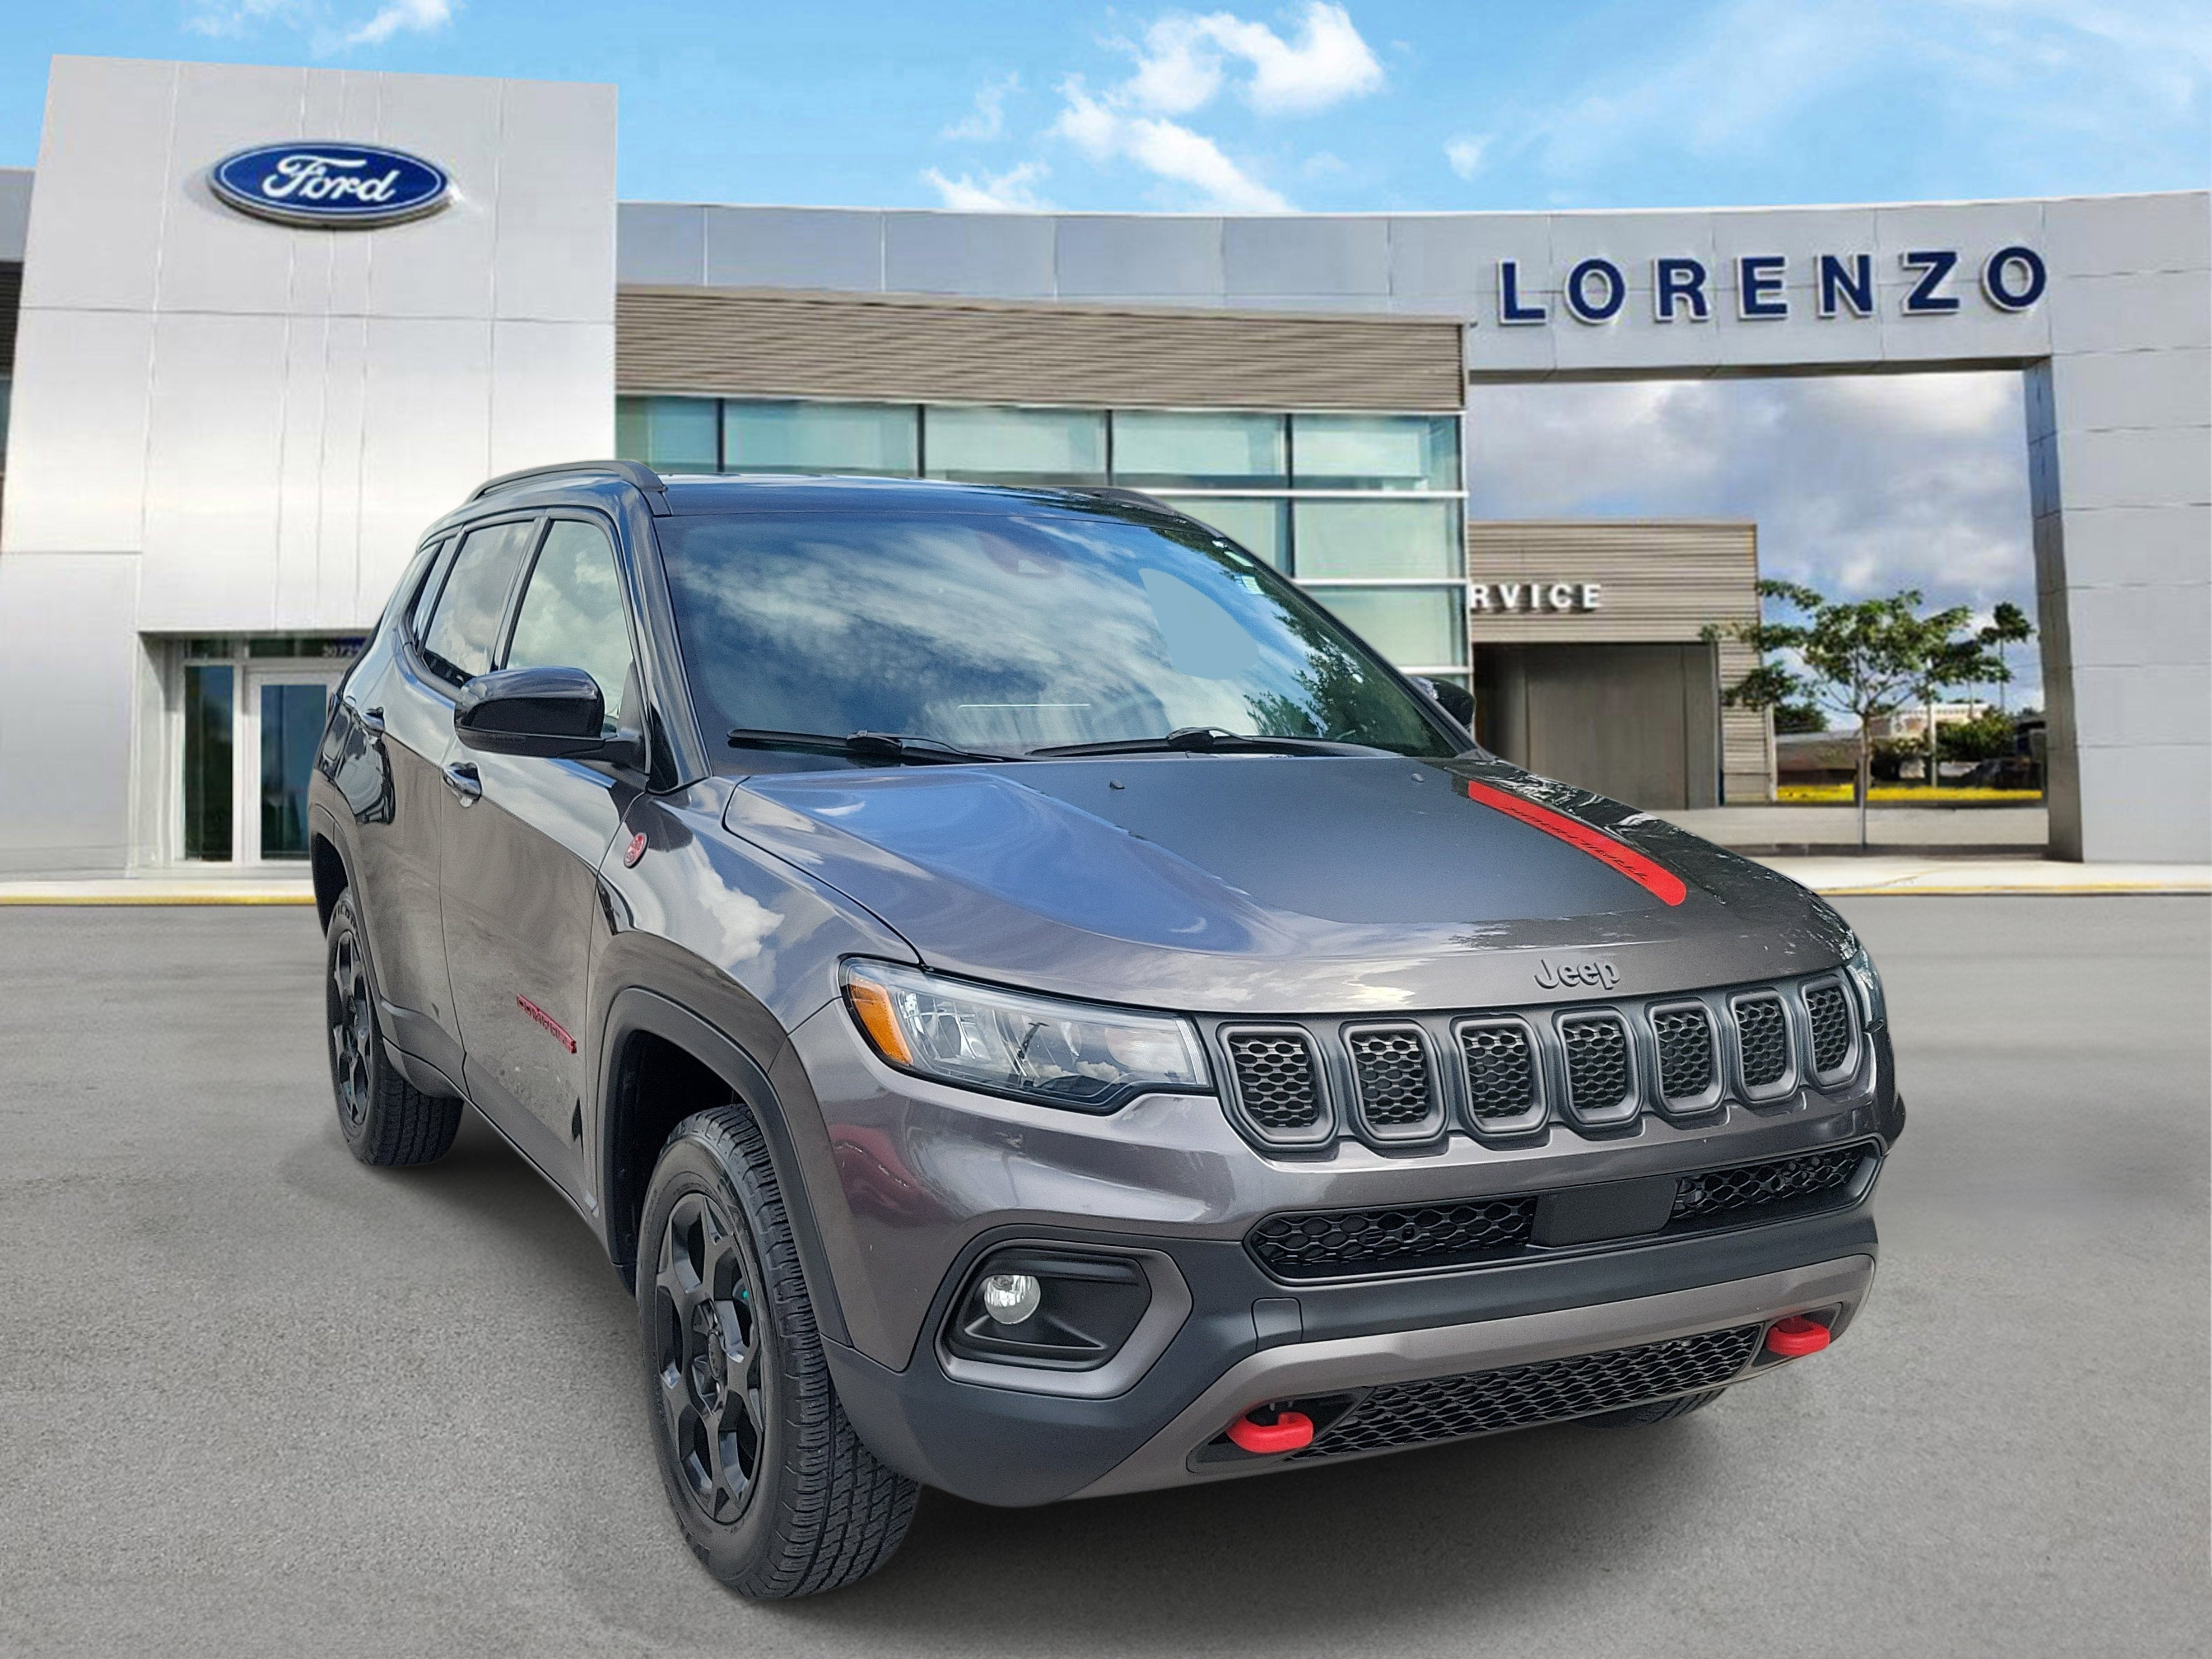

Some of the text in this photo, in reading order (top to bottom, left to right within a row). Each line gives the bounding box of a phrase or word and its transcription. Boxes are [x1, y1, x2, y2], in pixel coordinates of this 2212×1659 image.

[262, 154, 400, 201] Ford
[1498, 246, 2048, 322] LORENZO
[1534, 959, 1620, 990] Jeep
